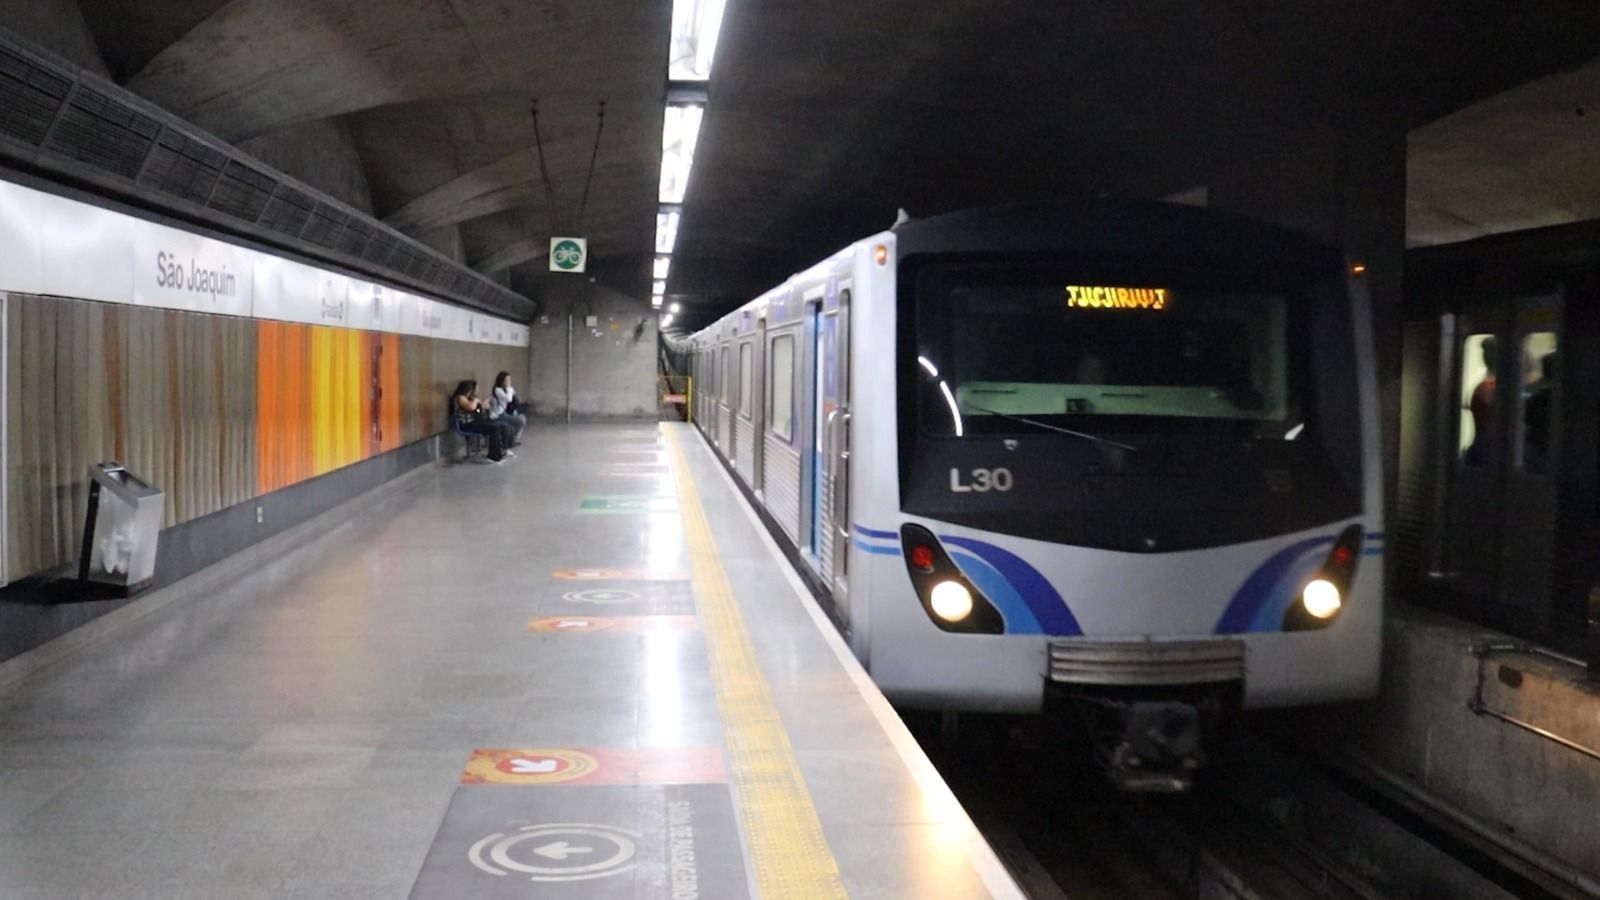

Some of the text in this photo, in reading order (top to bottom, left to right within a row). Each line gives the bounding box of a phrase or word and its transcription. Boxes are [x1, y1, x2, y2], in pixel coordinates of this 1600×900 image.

[156, 251, 236, 302] São Joaquim
[1065, 285, 1166, 310] TUCURUVI
[949, 467, 1014, 493] L30
